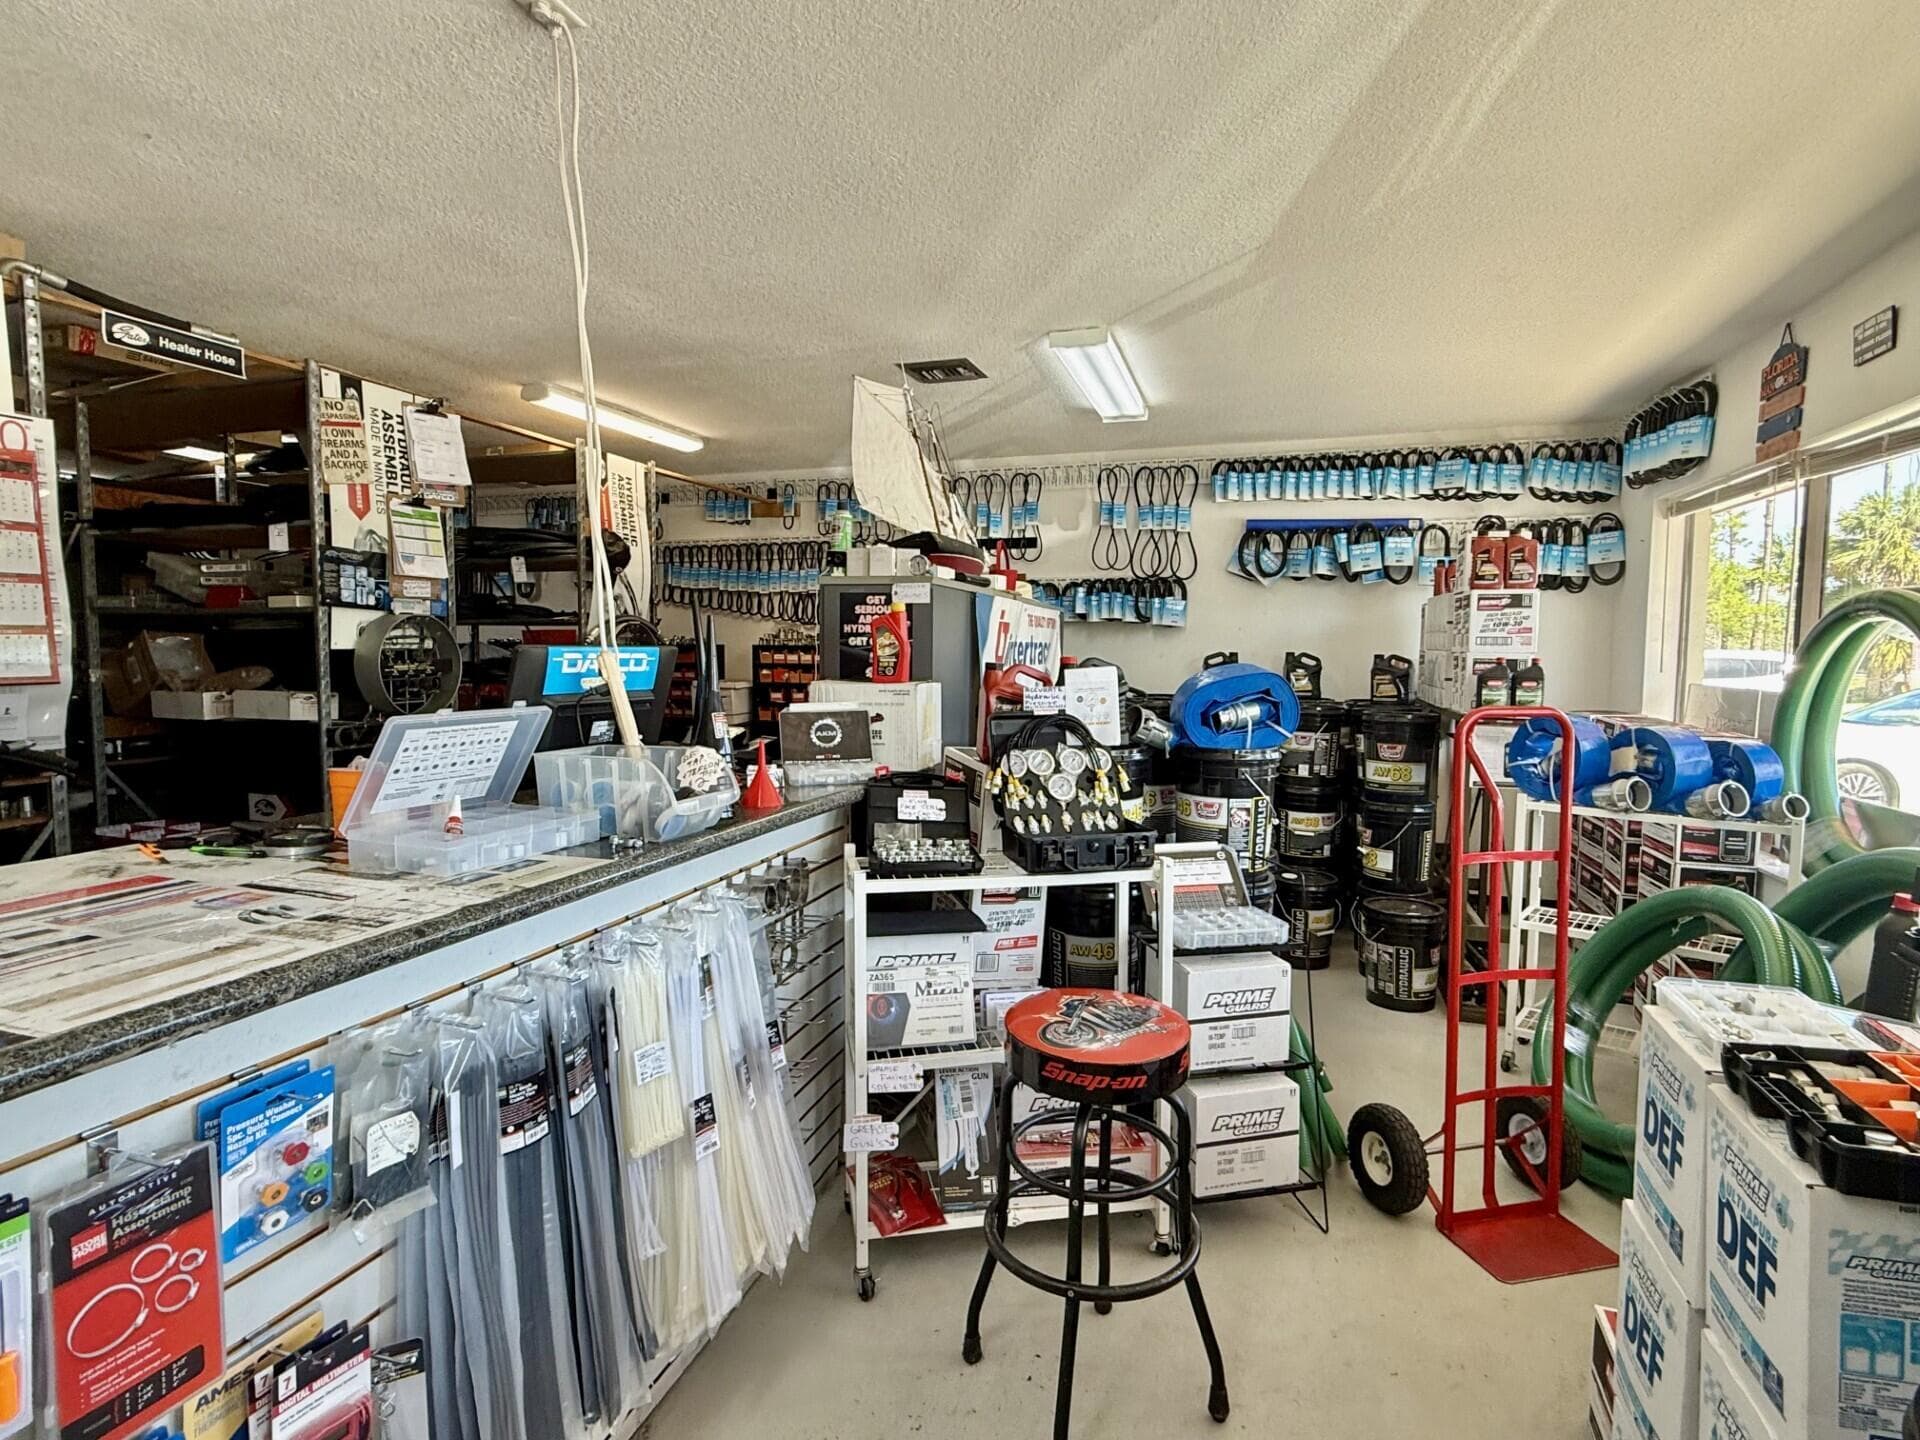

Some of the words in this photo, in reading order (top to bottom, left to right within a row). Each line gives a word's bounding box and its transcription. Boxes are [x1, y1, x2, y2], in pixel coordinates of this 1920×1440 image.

[112, 325, 148, 343] Gates
[159, 336, 202, 357] Heater
[204, 348, 236, 366] Hose
[1763, 352, 1799, 379] FLORIDA
[320, 412, 360, 421] ESPASSING
[324, 401, 344, 411] NO
[331, 428, 355, 438] OWN
[369, 406, 381, 442] MADE
[320, 439, 366, 449] FIREARMS
[330, 450, 350, 459] AND
[352, 451, 359, 459] A
[372, 445, 382, 457] IN
[324, 461, 368, 470] BACKHOE
[373, 461, 386, 515] MINUTES
[625, 476, 638, 547] HYDRAULIC
[854, 605, 892, 614] SERIOU
[866, 595, 886, 605] GET
[843, 624, 872, 633] HYDR
[1493, 620, 1523, 628] 10W-30
[848, 637, 868, 646] GET
[561, 652, 650, 673] DACO
[1255, 799, 1267, 869] HYDRAULIC
[996, 919, 1025, 928] 15W-40
[875, 953, 957, 967] PRIME
[869, 973, 895, 981] ZA365
[1399, 948, 1409, 999] HYDRAULIC
[1203, 987, 1276, 1008] PRIME
[1224, 1002, 1271, 1014] GUARD
[971, 1072, 989, 1080] GUN
[1041, 1062, 1148, 1091] Snap-on
[1651, 1054, 1682, 1094] PRIME
[227, 1114, 264, 1136] Pressure
[265, 1100, 296, 1117] Washer
[247, 1119, 269, 1135] Quick
[270, 1104, 303, 1124] Connect
[1211, 1107, 1285, 1132] PRIME
[1233, 1122, 1280, 1136] GUARD
[227, 1138, 254, 1153] Nozzle
[255, 1128, 267, 1140] Kit
[1643, 1096, 1685, 1179] DEF
[1724, 1146, 1770, 1203] PRIME
[88, 1171, 178, 1216] AUTOMOTIVE
[1737, 1175, 1766, 1213] GUARD
[112, 1196, 193, 1240] Assortment
[1727, 1184, 1779, 1249] ULTRAPURE
[1717, 1197, 1778, 1309] DEF
[1623, 1292, 1665, 1388] DEF
[195, 1364, 257, 1412] AMES
[260, 1375, 269, 1389] 7
[278, 1384, 311, 1413] DIGITAL
[311, 1353, 365, 1393] MULTIMETER
[283, 1376, 292, 1391] 7
